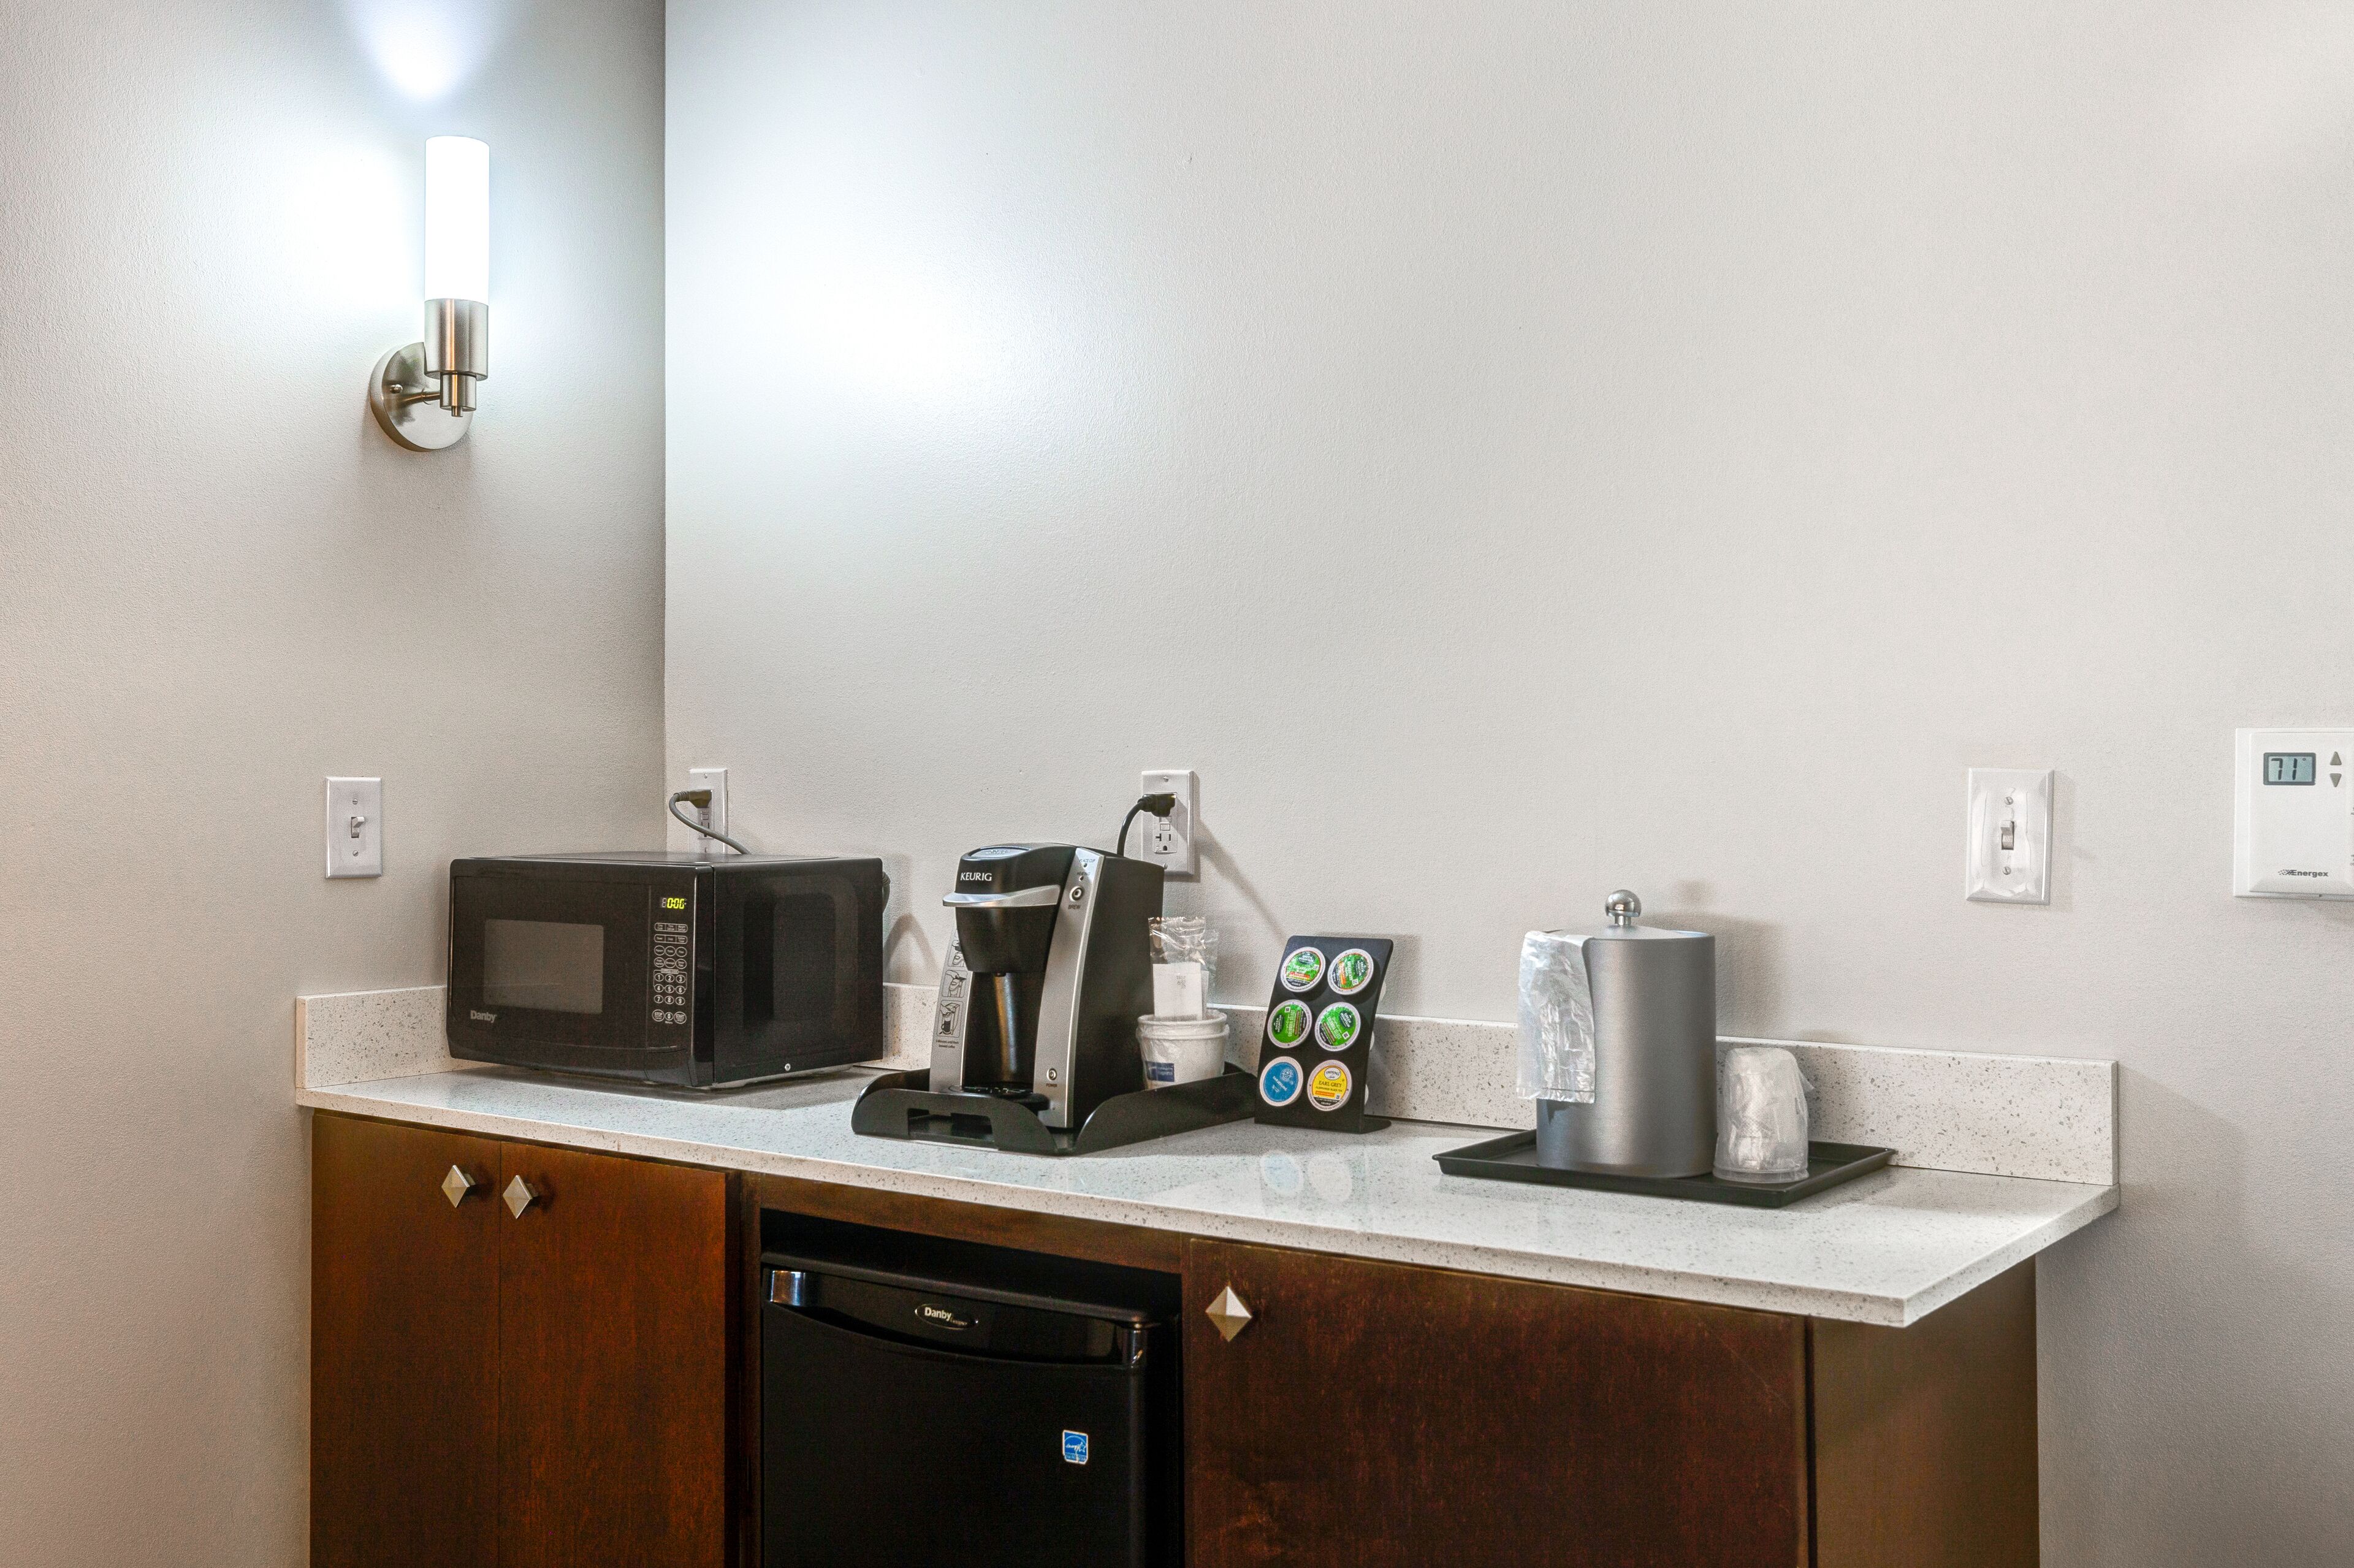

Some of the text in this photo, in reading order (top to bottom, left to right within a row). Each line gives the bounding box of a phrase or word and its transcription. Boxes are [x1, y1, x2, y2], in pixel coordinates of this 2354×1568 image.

[960, 872, 992, 881] KEURIG
[2289, 869, 2329, 878] Energex
[471, 1010, 496, 1023] Danby
[1340, 1013, 1350, 1027] MOUNTAIN
[924, 1307, 952, 1321] Danby
